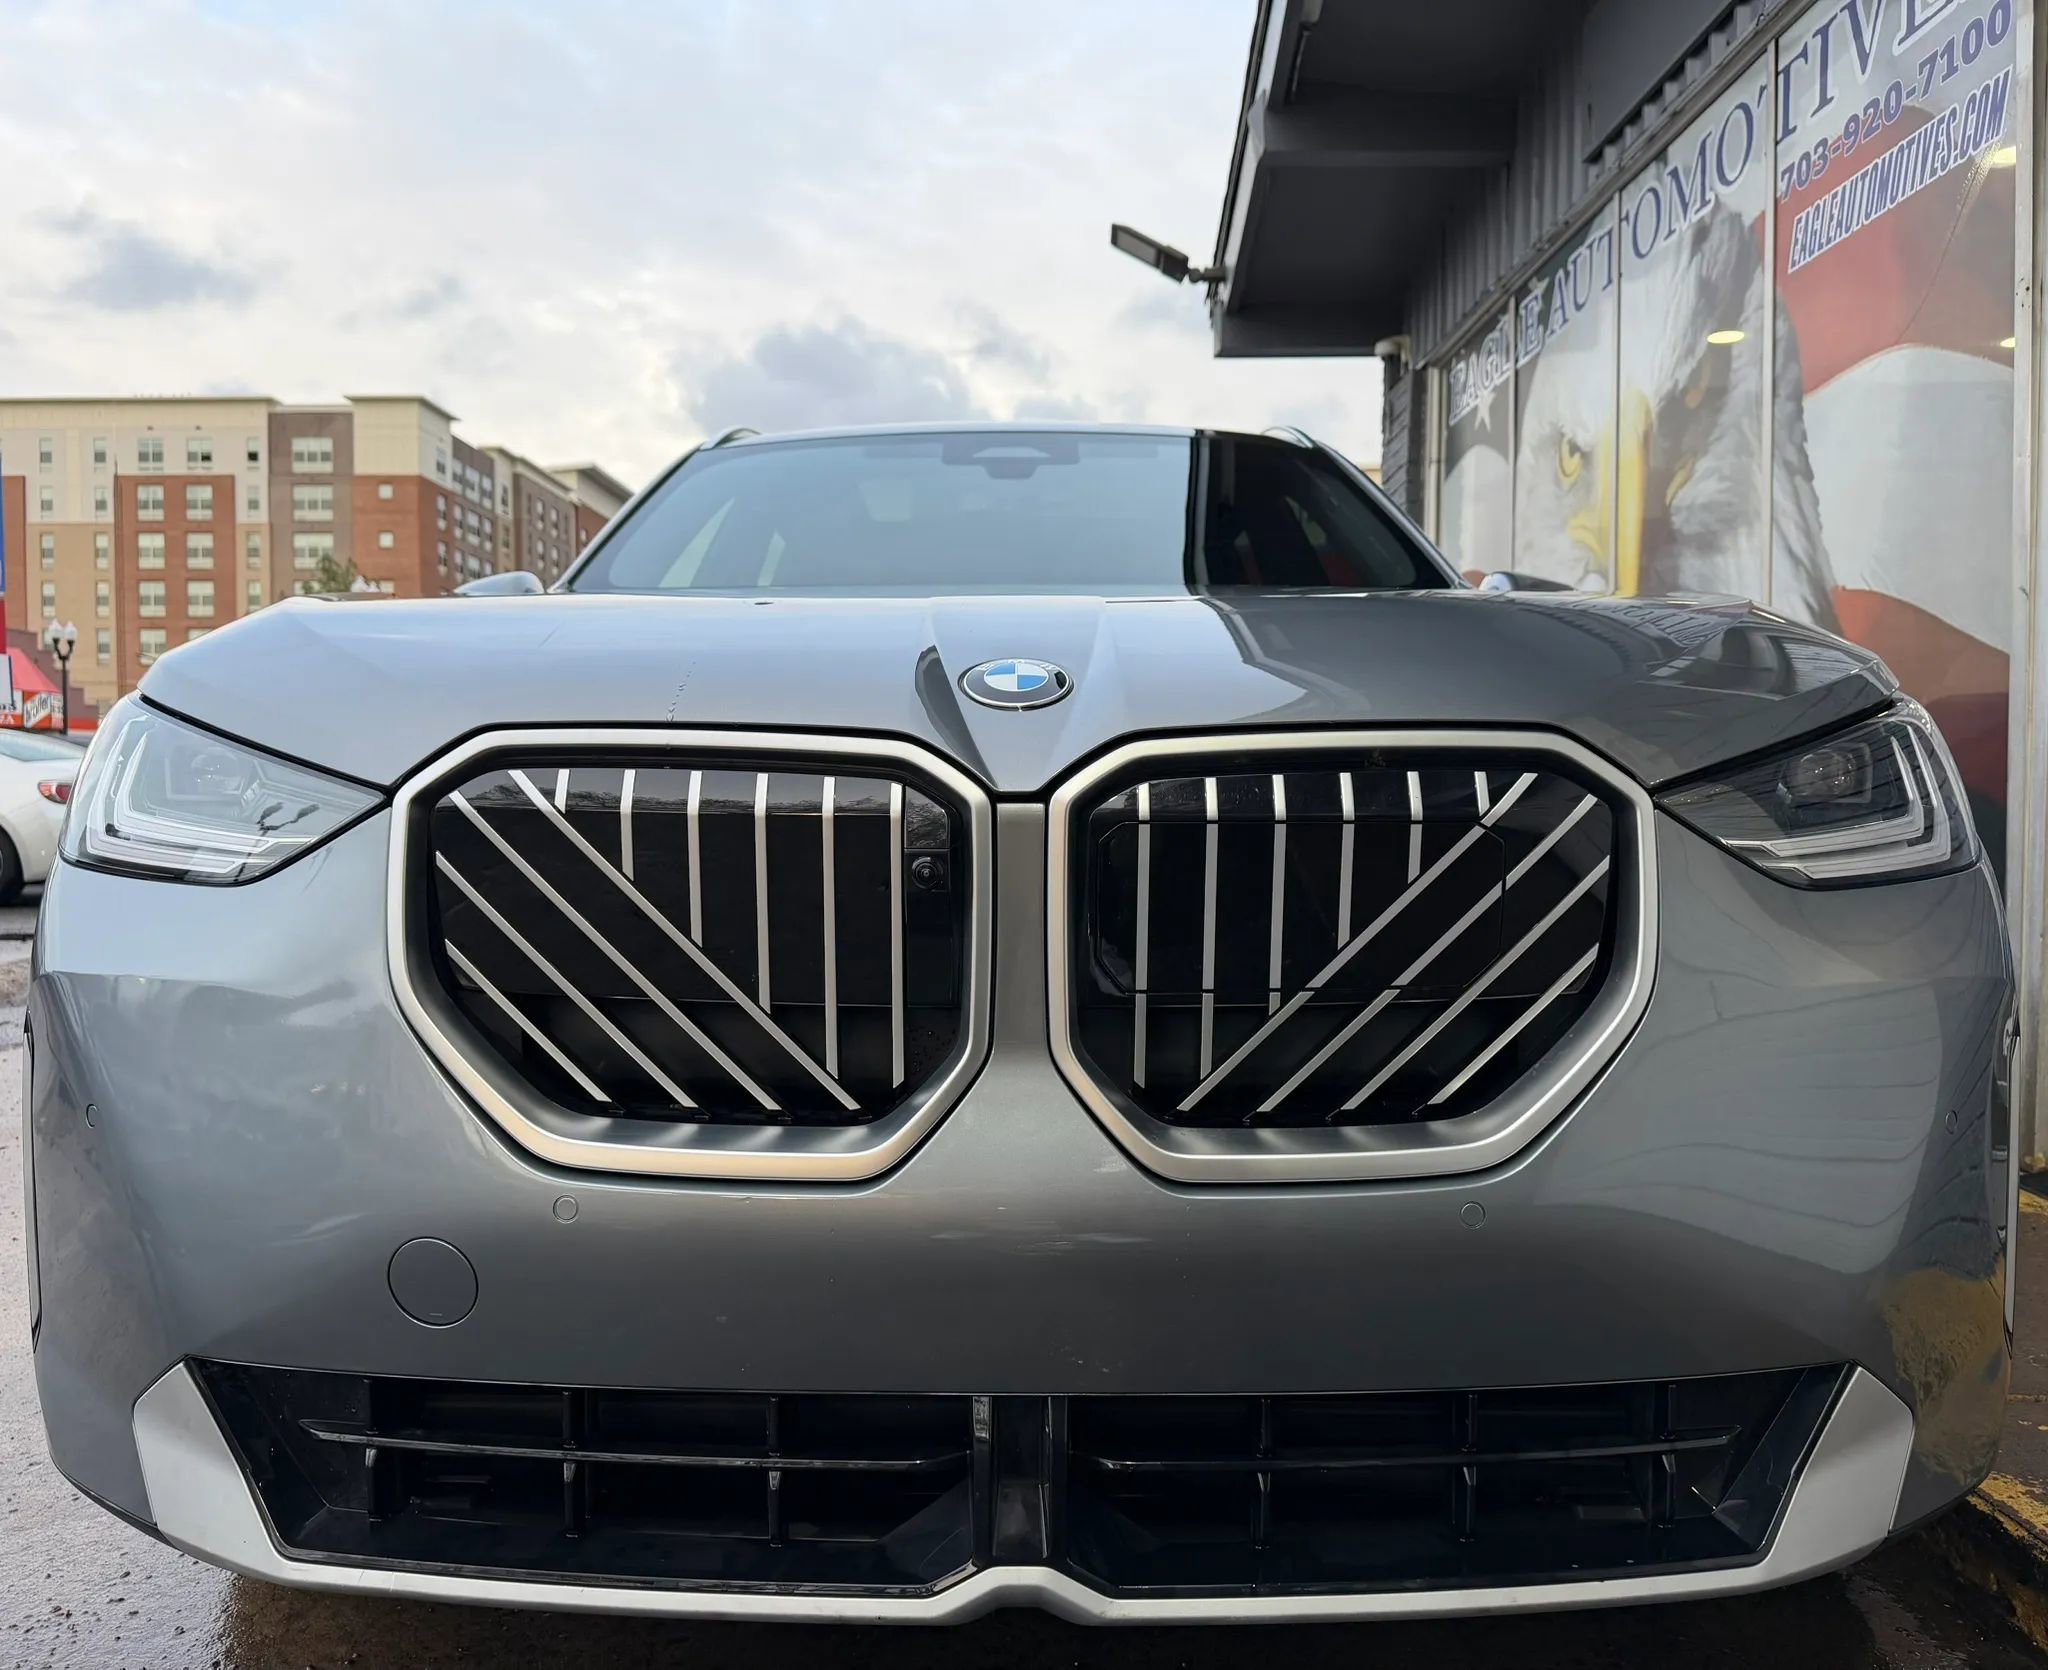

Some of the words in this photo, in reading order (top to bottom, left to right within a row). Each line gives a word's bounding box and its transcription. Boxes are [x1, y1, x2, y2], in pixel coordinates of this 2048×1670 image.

[1780, 0, 2012, 203] 703-920-7100
[1788, 64, 2013, 274] EAGLEAUTOMOTIVES.COM
[1449, 290, 1544, 426] EAGLE
